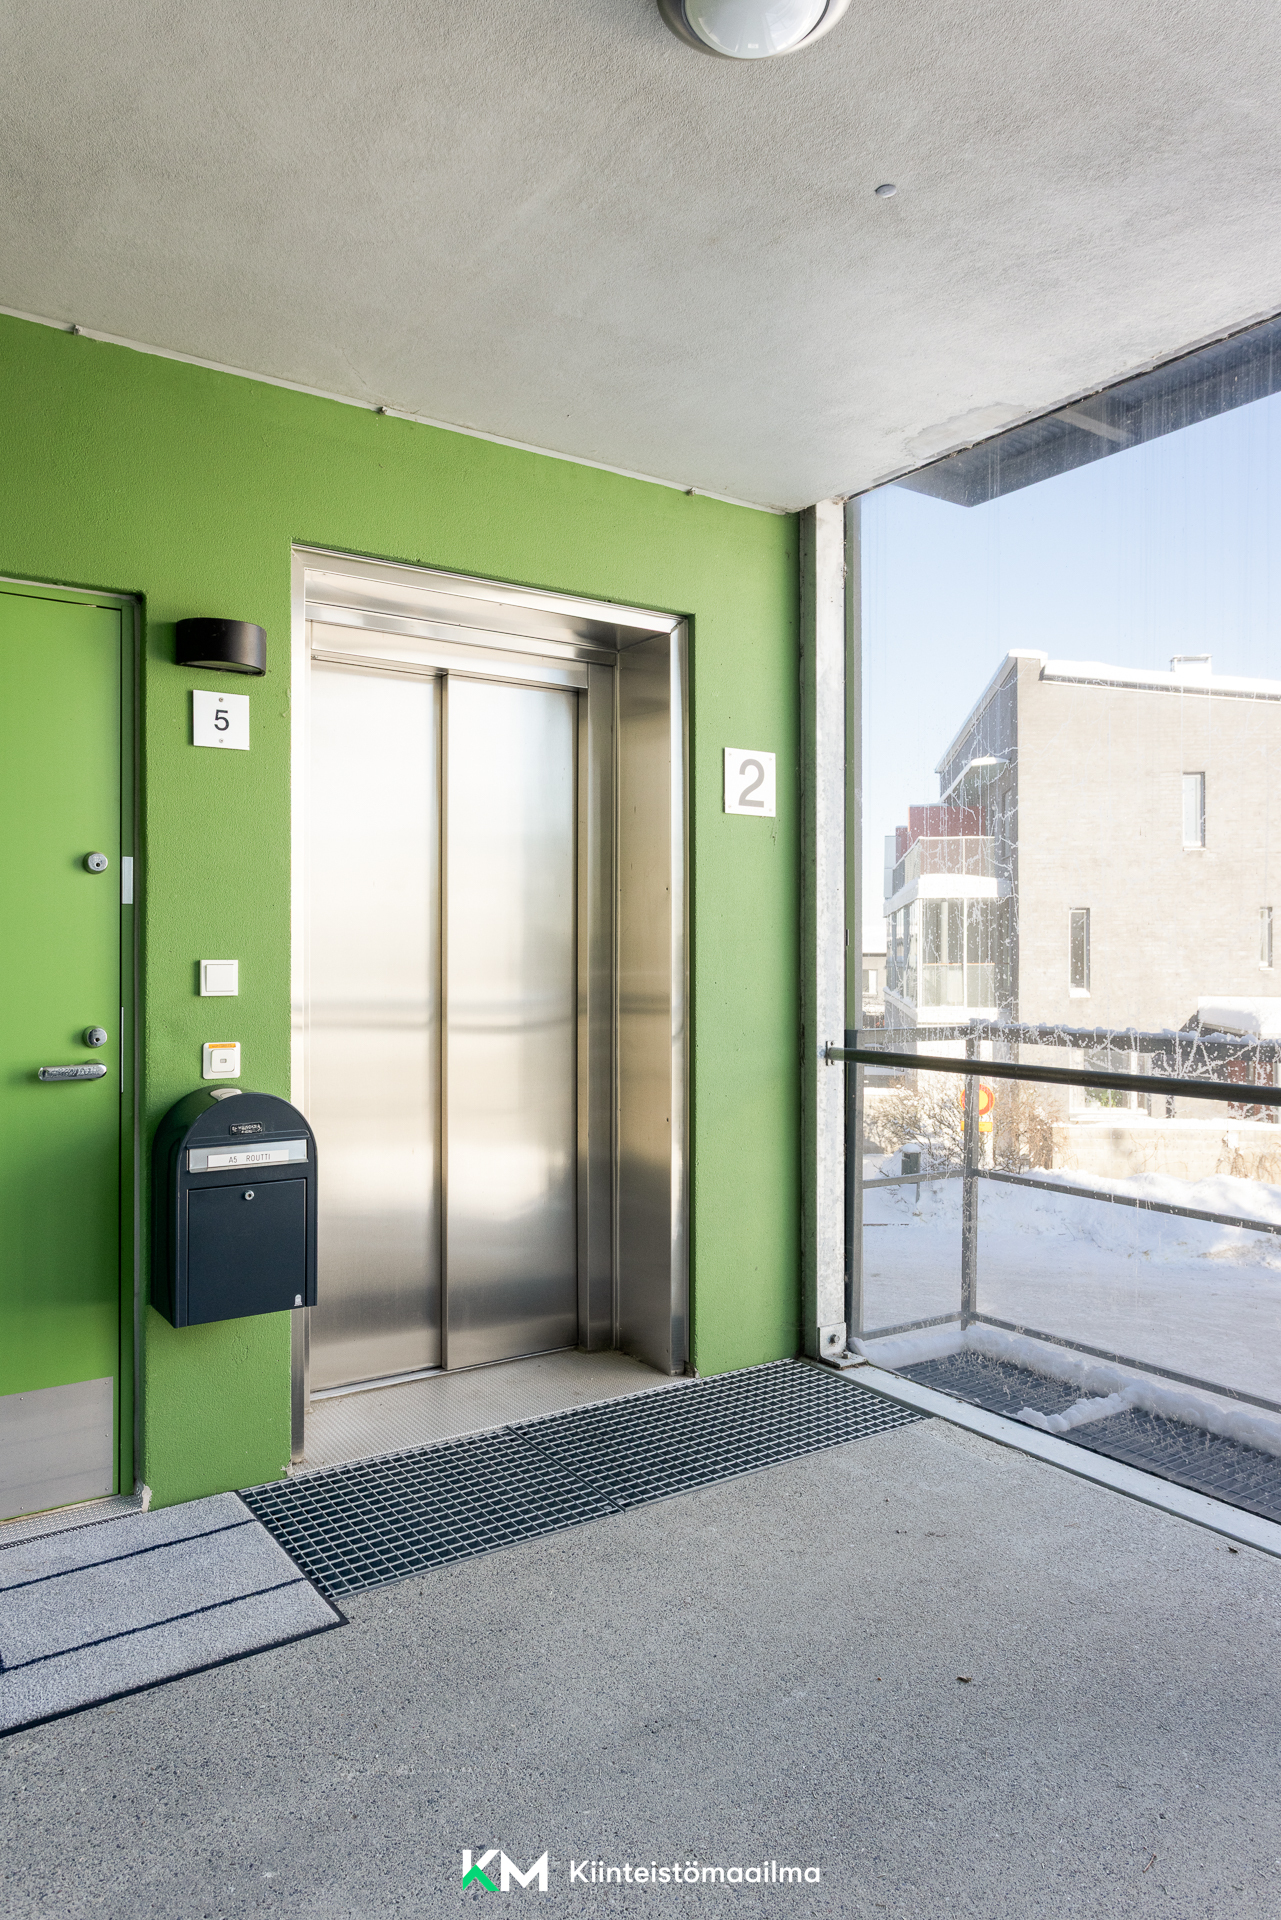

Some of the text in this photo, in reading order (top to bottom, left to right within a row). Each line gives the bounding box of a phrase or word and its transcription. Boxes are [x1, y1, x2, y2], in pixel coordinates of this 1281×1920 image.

[214, 709, 229, 731] 5
[738, 758, 765, 808] 2
[245, 1153, 271, 1162] ROUTTI
